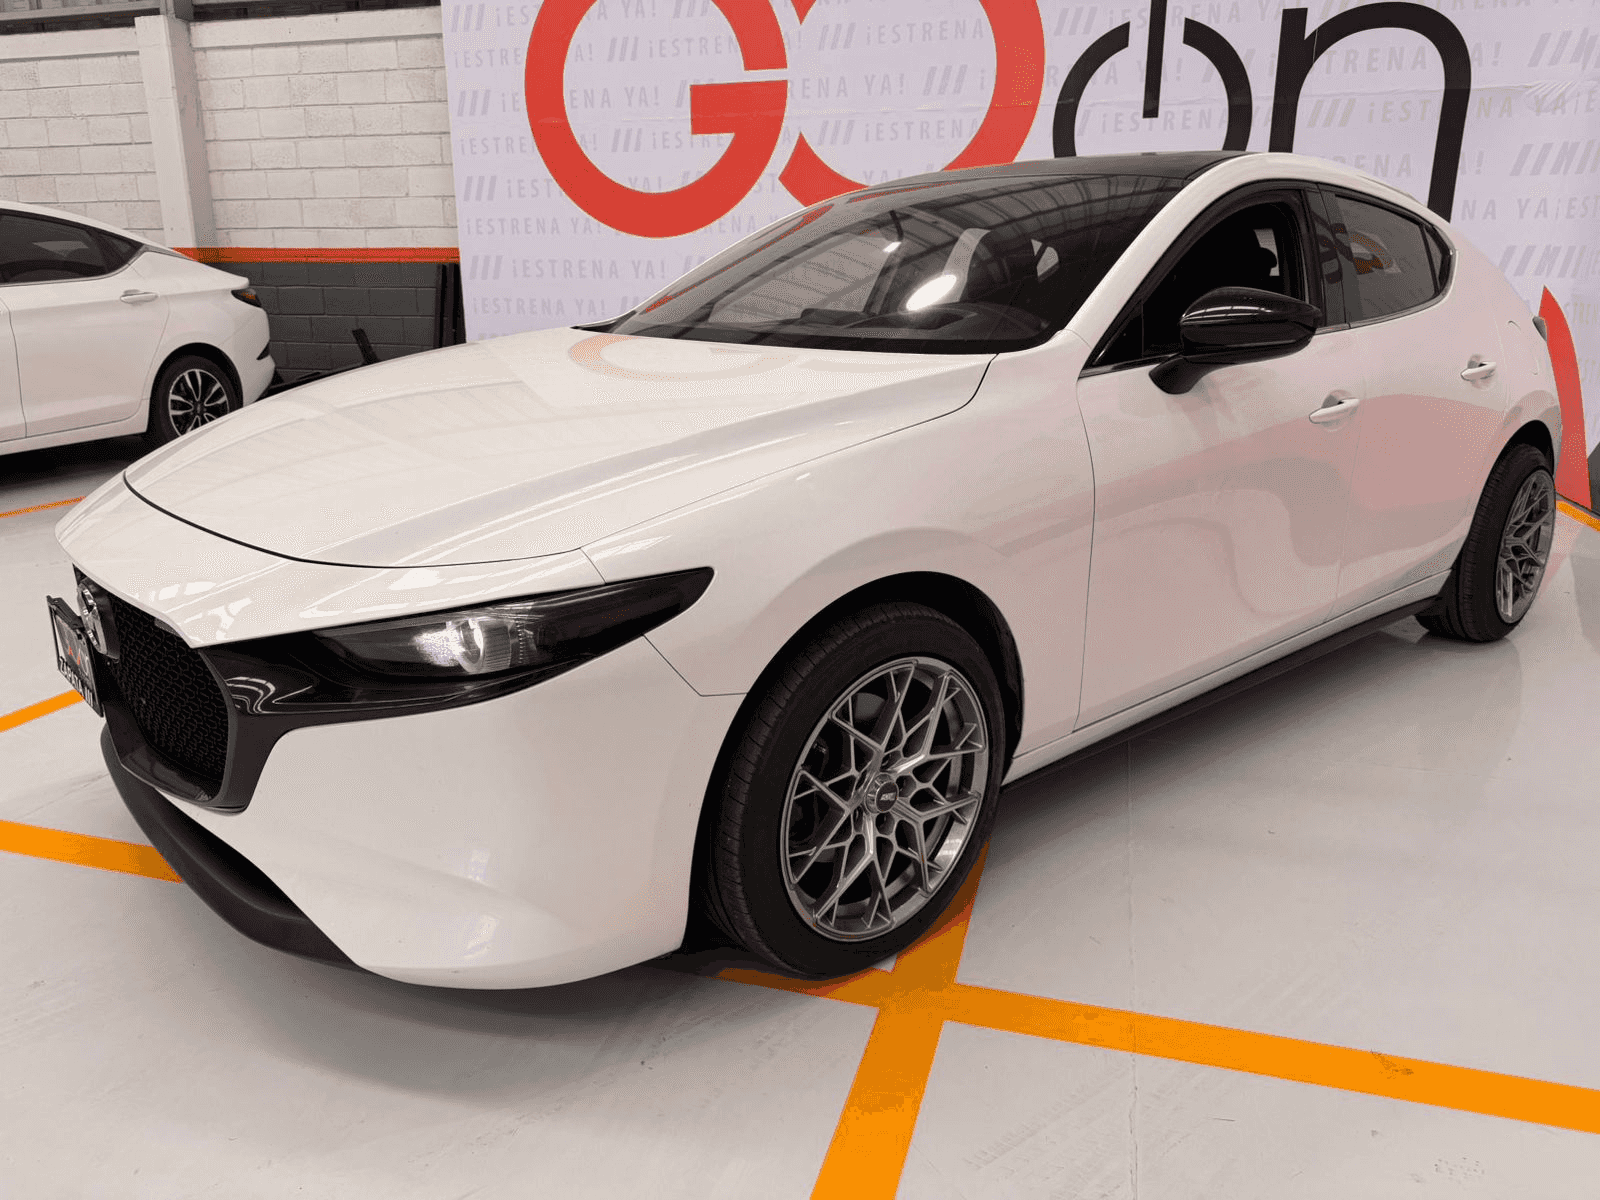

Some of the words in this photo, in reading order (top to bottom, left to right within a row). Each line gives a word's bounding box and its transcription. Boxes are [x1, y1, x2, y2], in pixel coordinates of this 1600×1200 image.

[453, 46, 523, 68] ¡ESTRE
[866, 18, 984, 46] ¡ESTRENA
[624, 85, 660, 109] YA!
[864, 73, 905, 96] YA!
[466, 216, 561, 236] ¡ESTRENA
[512, 258, 619, 280] ¡ESTRENA
[631, 258, 665, 280] YA!
[473, 297, 565, 316] ¡ESTRENA
[574, 298, 606, 317] YA!
